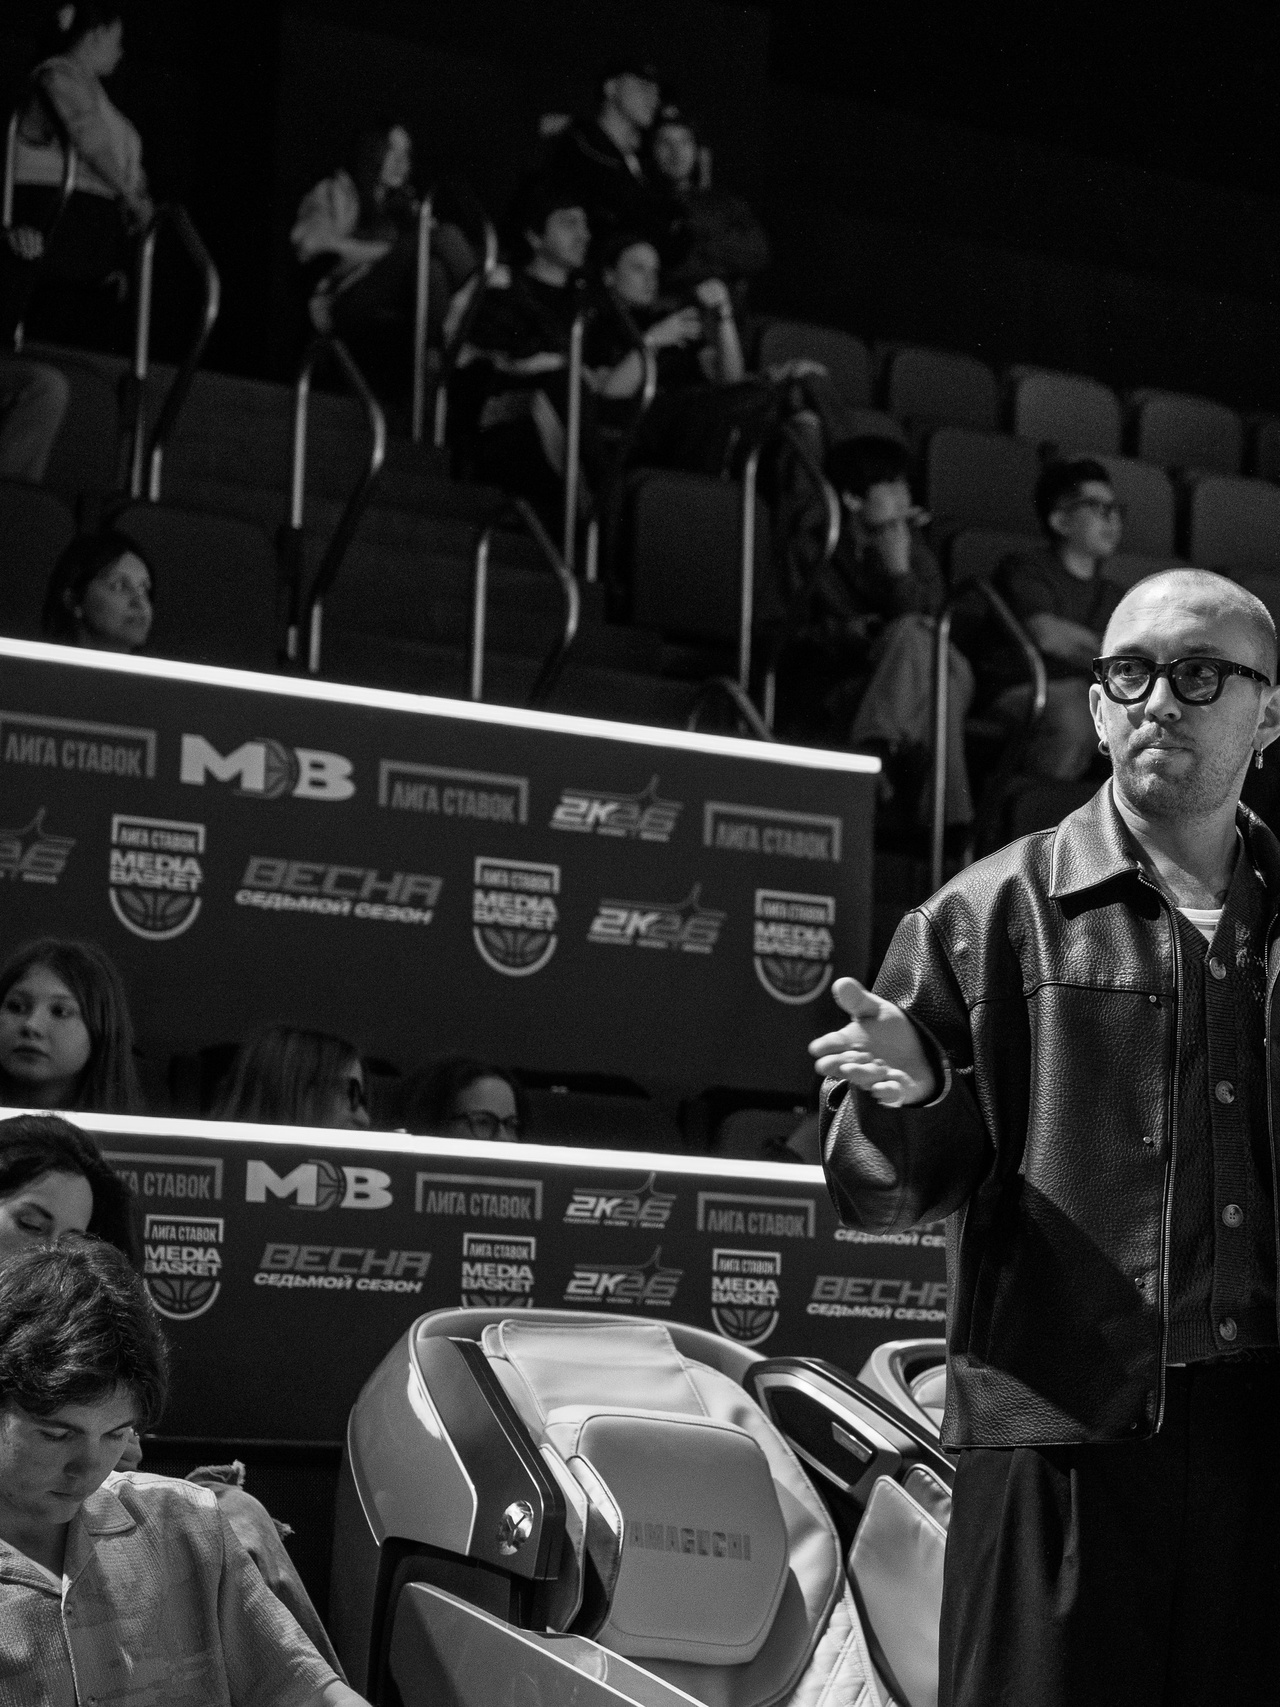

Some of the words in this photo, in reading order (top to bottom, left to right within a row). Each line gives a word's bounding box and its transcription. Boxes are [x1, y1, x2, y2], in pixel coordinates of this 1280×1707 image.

[5, 732, 57, 768] ЛИГА
[61, 738, 142, 779] СТАВОК
[110, 848, 201, 875] MEDIA
[243, 855, 443, 907] ВЕСНА
[235, 889, 352, 916] СЕДЬМОЙ
[353, 902, 433, 925] СЕЗОН
[143, 1171, 211, 1200] СТАВОК
[425, 1189, 466, 1215] ЛИГА
[469, 1192, 531, 1220] СТАВОК
[565, 1194, 673, 1223] 2K26
[151, 1224, 176, 1241] ЛИГА
[178, 1226, 217, 1243] СТАВОК
[707, 1208, 745, 1234] ЛИГА
[144, 1244, 221, 1263] MEDIA
[259, 1242, 432, 1279] ВЕСНА
[144, 1261, 222, 1277] BASKET
[253, 1272, 353, 1290] СЕДЬМОЙ
[355, 1277, 423, 1294] СЕЗОН
[462, 1261, 534, 1281] MEDIA
[565, 1271, 681, 1300] 2K26
[712, 1276, 780, 1294] MEDIA
[624, 1520, 751, 1562] AMAGUCHI
